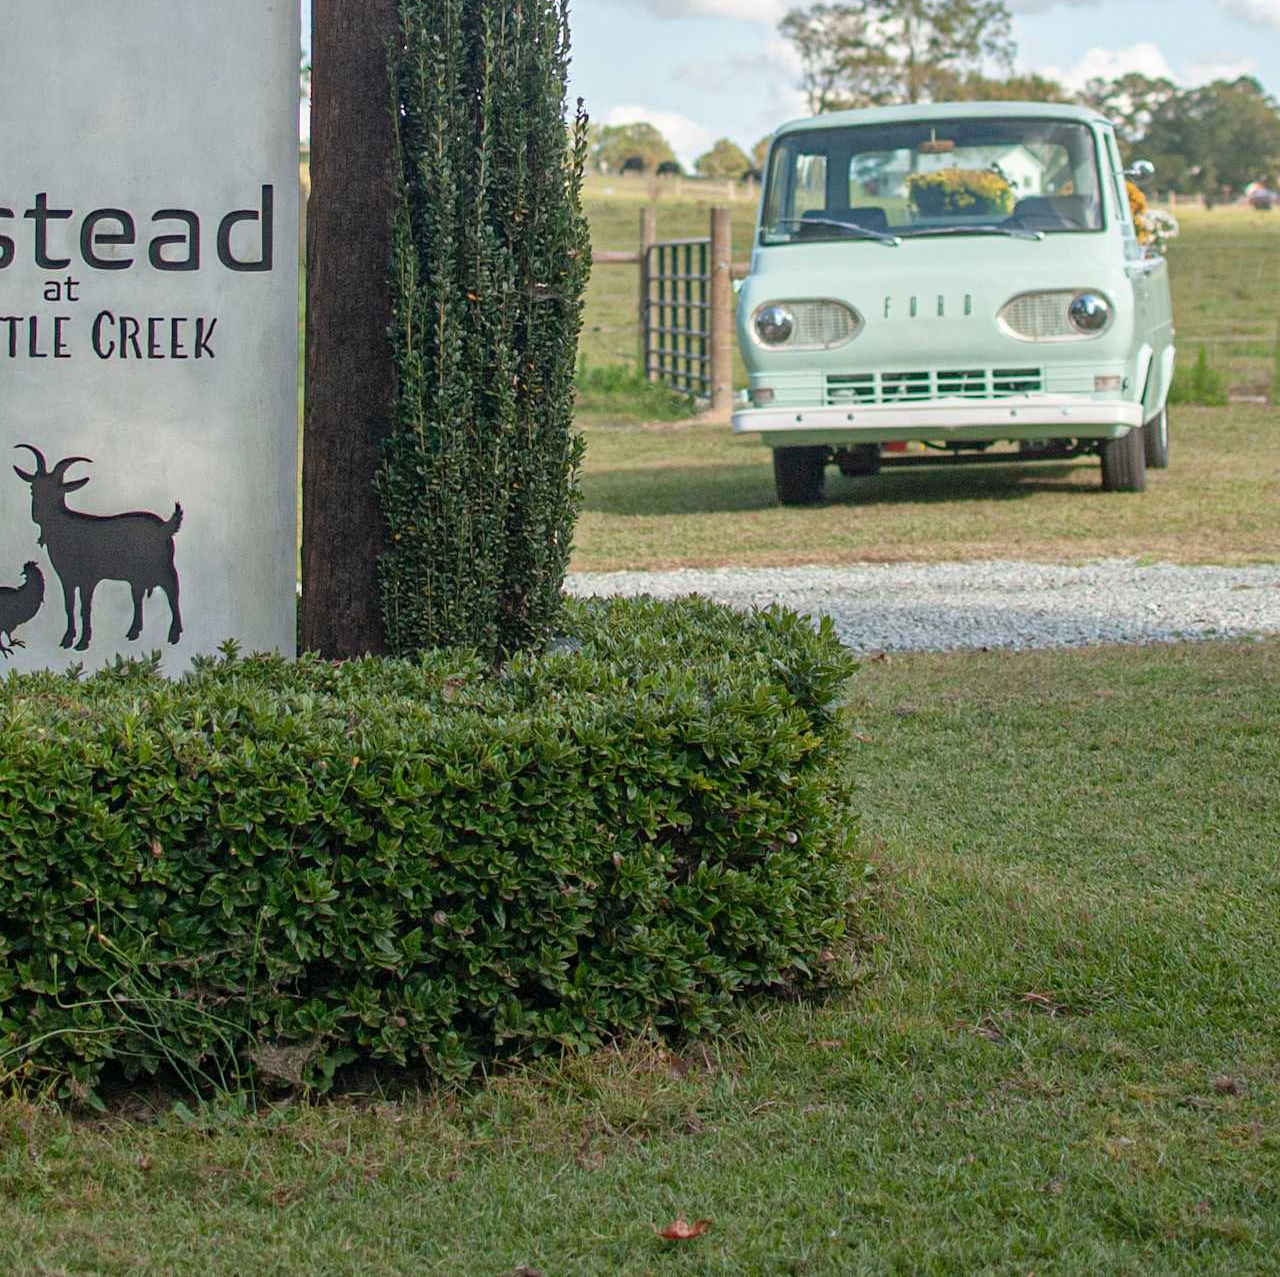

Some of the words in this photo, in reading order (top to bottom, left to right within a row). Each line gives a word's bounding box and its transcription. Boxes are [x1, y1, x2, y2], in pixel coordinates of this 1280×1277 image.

[43, 276, 80, 302] at
[883, 293, 972, 319] FORD
[91, 309, 218, 360] CREEK
